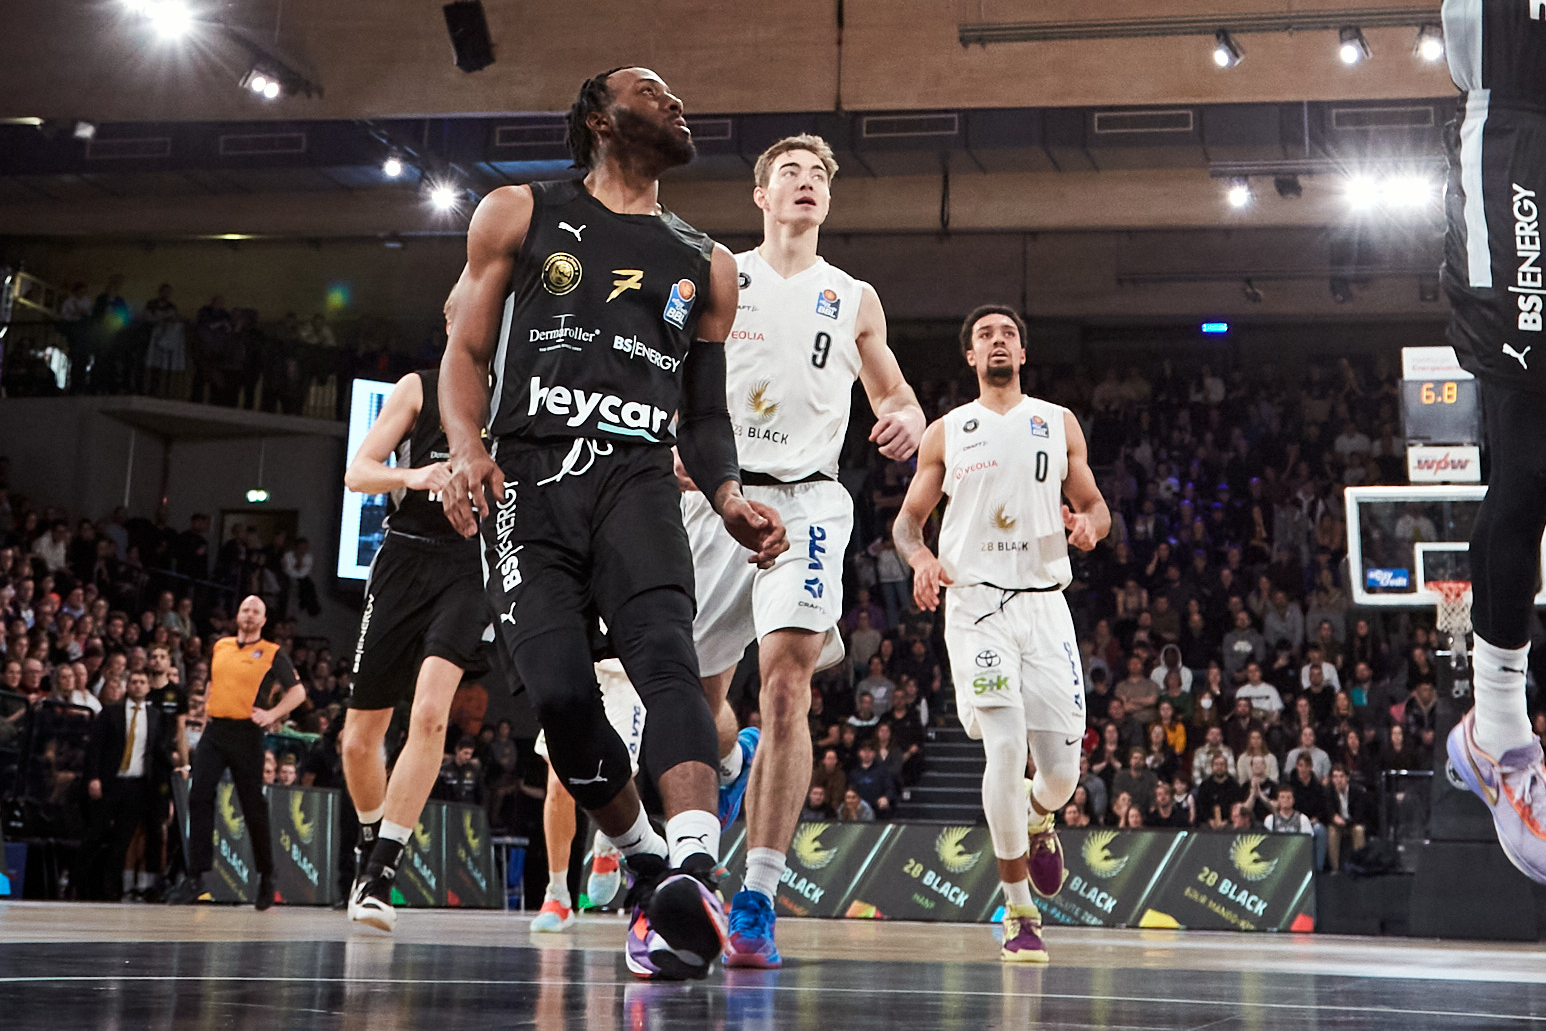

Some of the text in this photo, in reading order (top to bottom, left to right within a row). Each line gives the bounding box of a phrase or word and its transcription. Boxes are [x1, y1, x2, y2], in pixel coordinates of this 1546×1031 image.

[605, 269, 645, 303] 7
[731, 331, 765, 342] EOLIA
[811, 331, 832, 369] 9
[527, 376, 668, 434] heycar
[1421, 381, 1458, 404] 6.8
[747, 426, 789, 445] BLACK
[1035, 449, 1049, 483] 0
[780, 866, 825, 905] BLACK
[902, 857, 970, 908] 28 BLACK
[1068, 874, 1118, 914] BLACK
[1197, 865, 1269, 918] 28 BLACK
